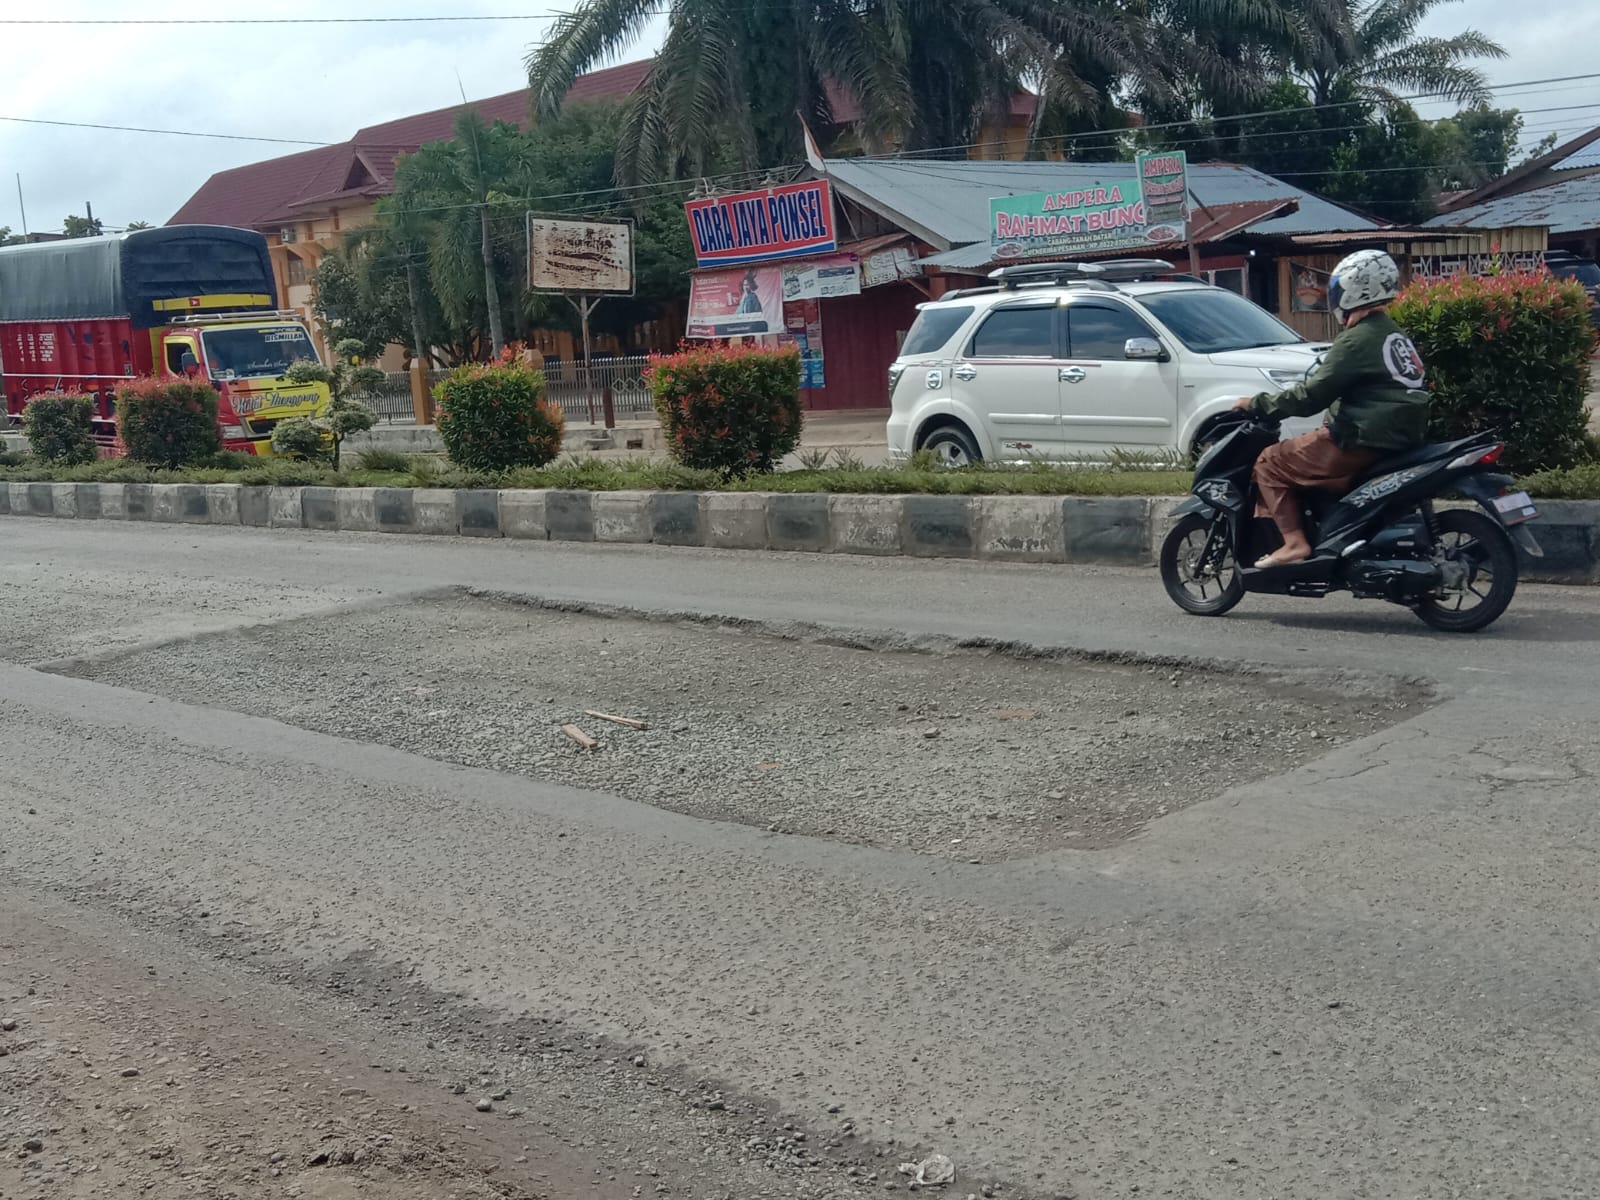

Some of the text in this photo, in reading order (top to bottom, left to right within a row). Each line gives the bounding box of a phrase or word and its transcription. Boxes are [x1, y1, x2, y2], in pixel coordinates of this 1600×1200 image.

[1144, 156, 1183, 176] AMPERA
[1042, 186, 1123, 212] AMPERA
[692, 189, 827, 252] DARA JAYA PONSEL
[997, 211, 1083, 239] RAHMAT
